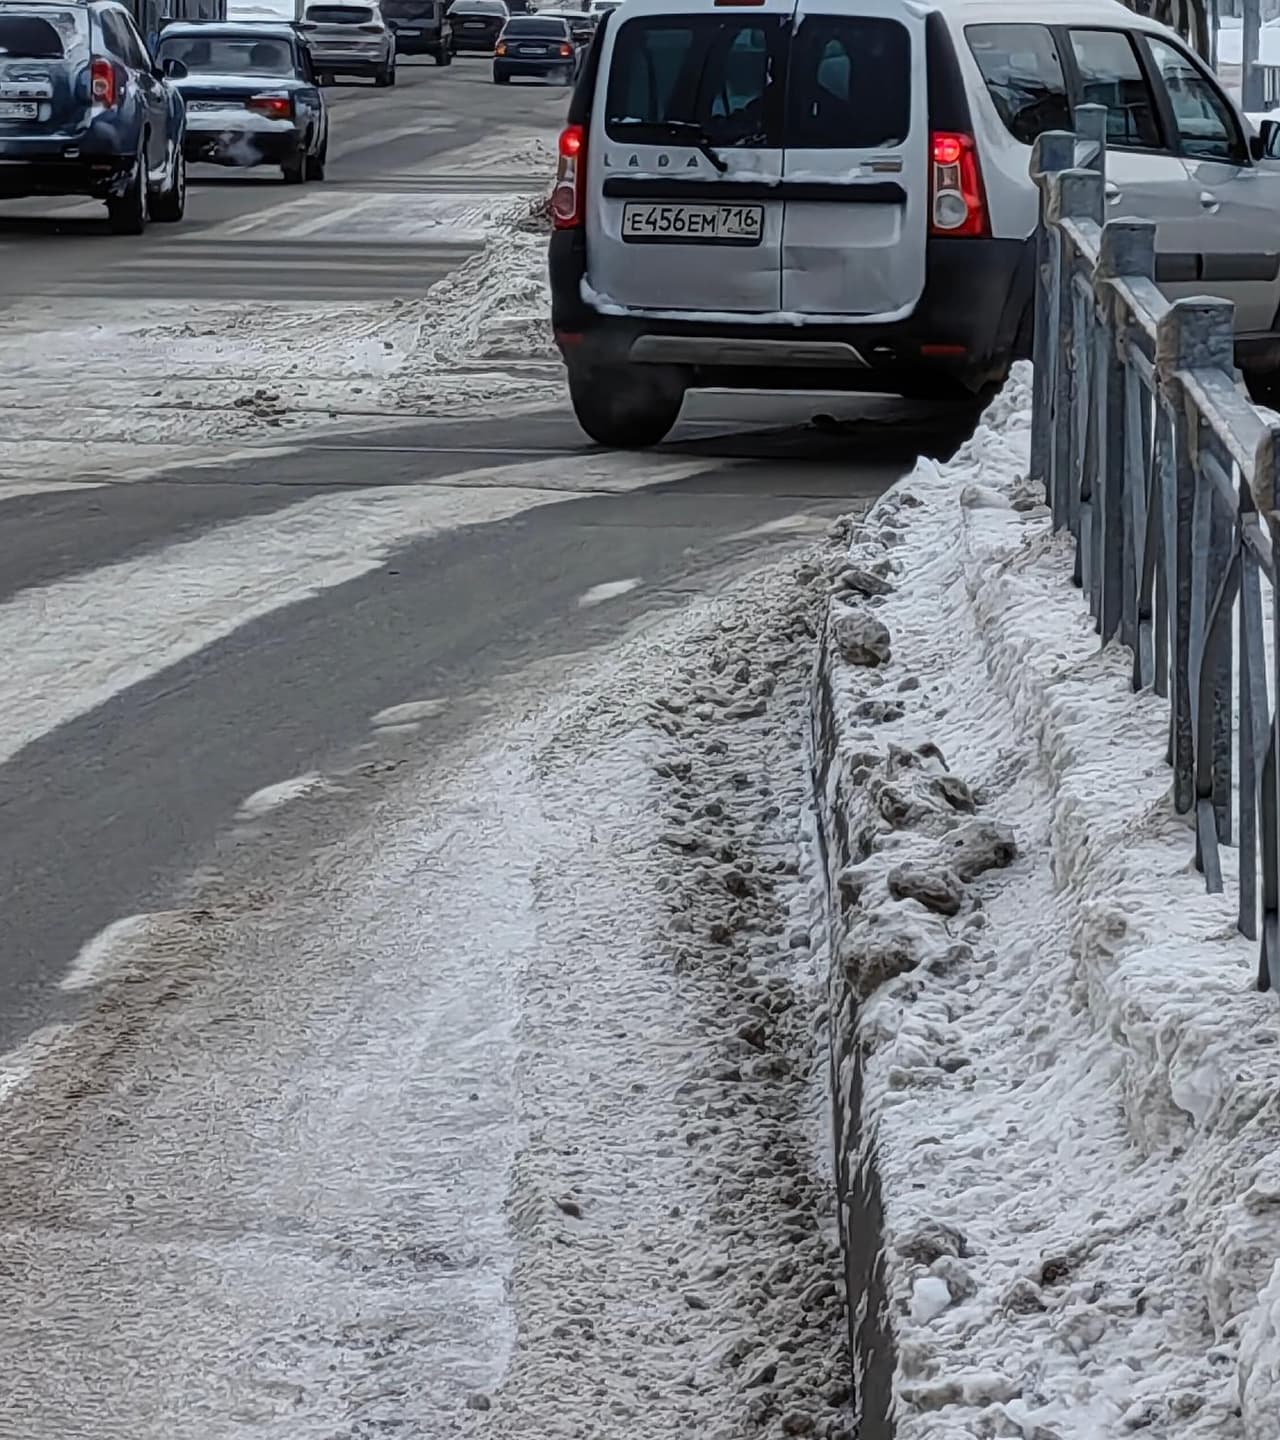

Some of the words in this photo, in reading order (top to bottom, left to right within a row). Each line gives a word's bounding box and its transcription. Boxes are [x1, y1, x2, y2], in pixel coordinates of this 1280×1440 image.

[605, 154, 700, 168] LADA
[632, 205, 716, 234] Е456ЕМ
[722, 208, 755, 228] 716
